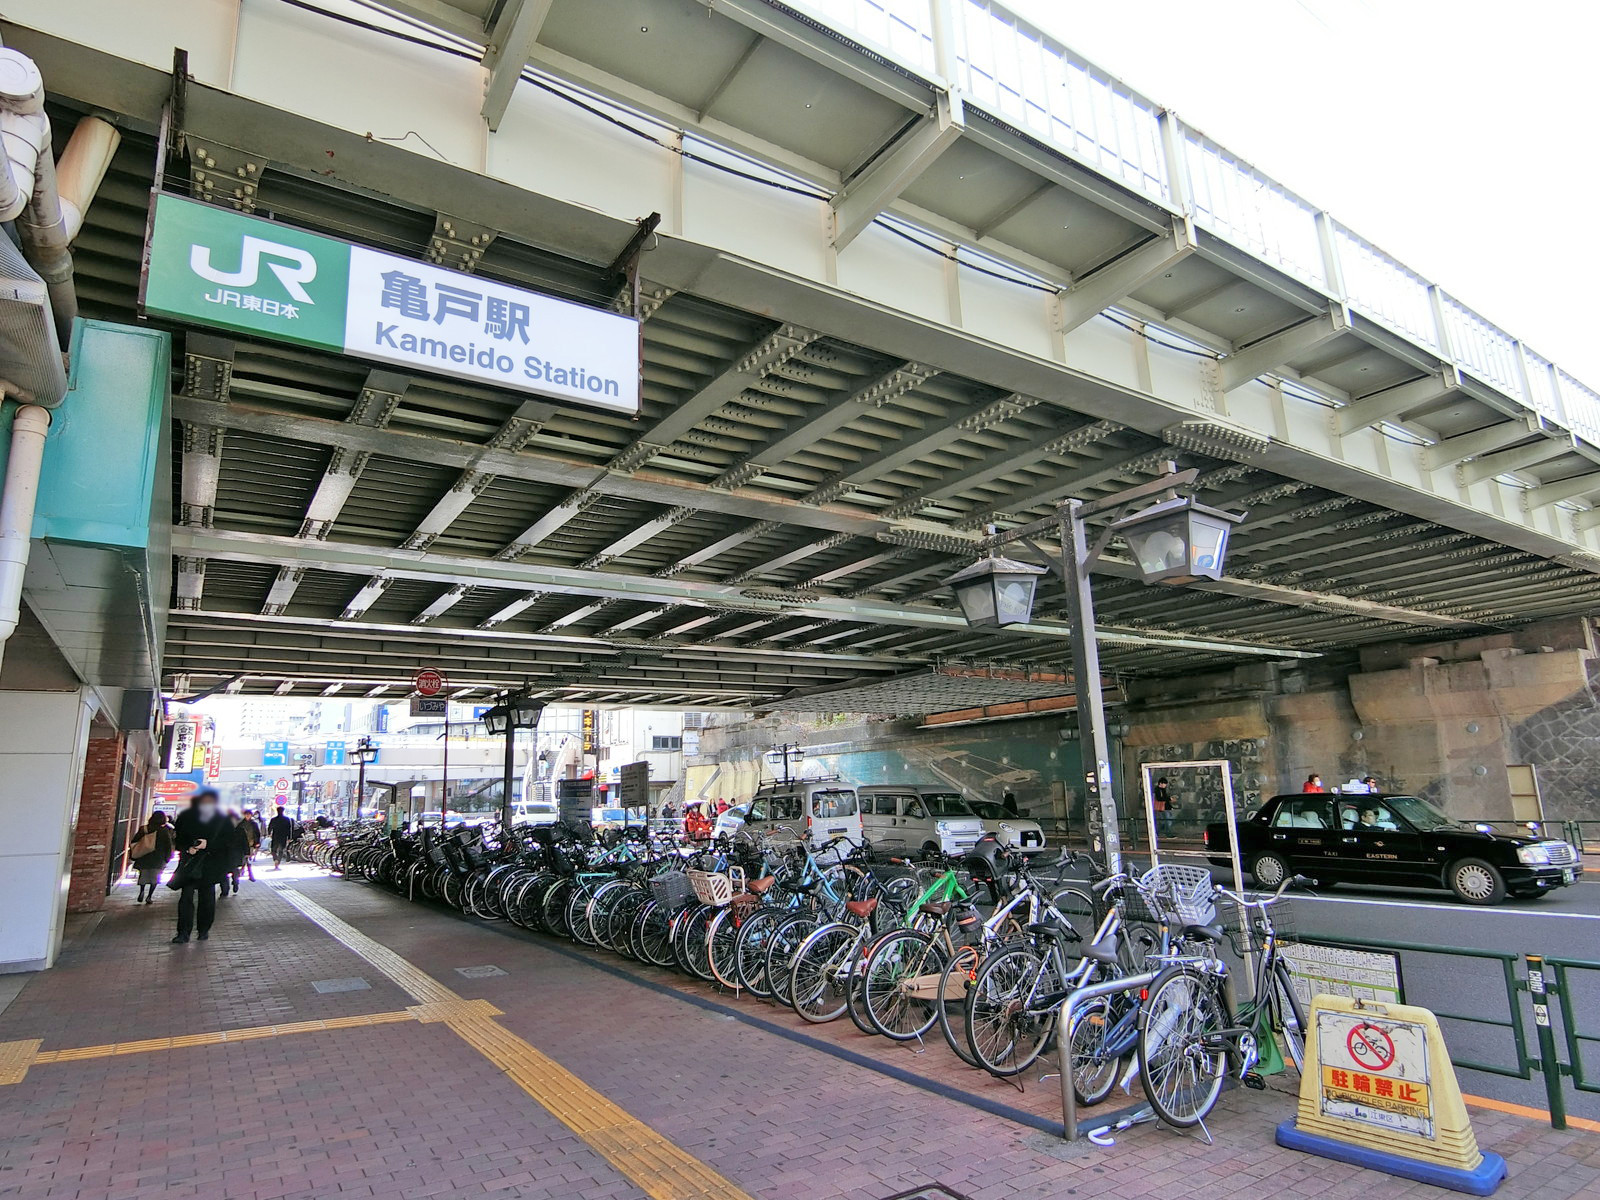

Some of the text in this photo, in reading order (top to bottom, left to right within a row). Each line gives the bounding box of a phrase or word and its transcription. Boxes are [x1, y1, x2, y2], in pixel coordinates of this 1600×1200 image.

[190, 234, 317, 305] JR
[204, 288, 300, 319] JR東日本
[380, 270, 531, 345] 亀戸駅
[375, 321, 619, 397] Kameido Station
[418, 678, 440, 689] 消火栓
[1331, 1069, 1419, 1102] 駐輪禁止
[1385, 1101, 1426, 1116] PARKING
